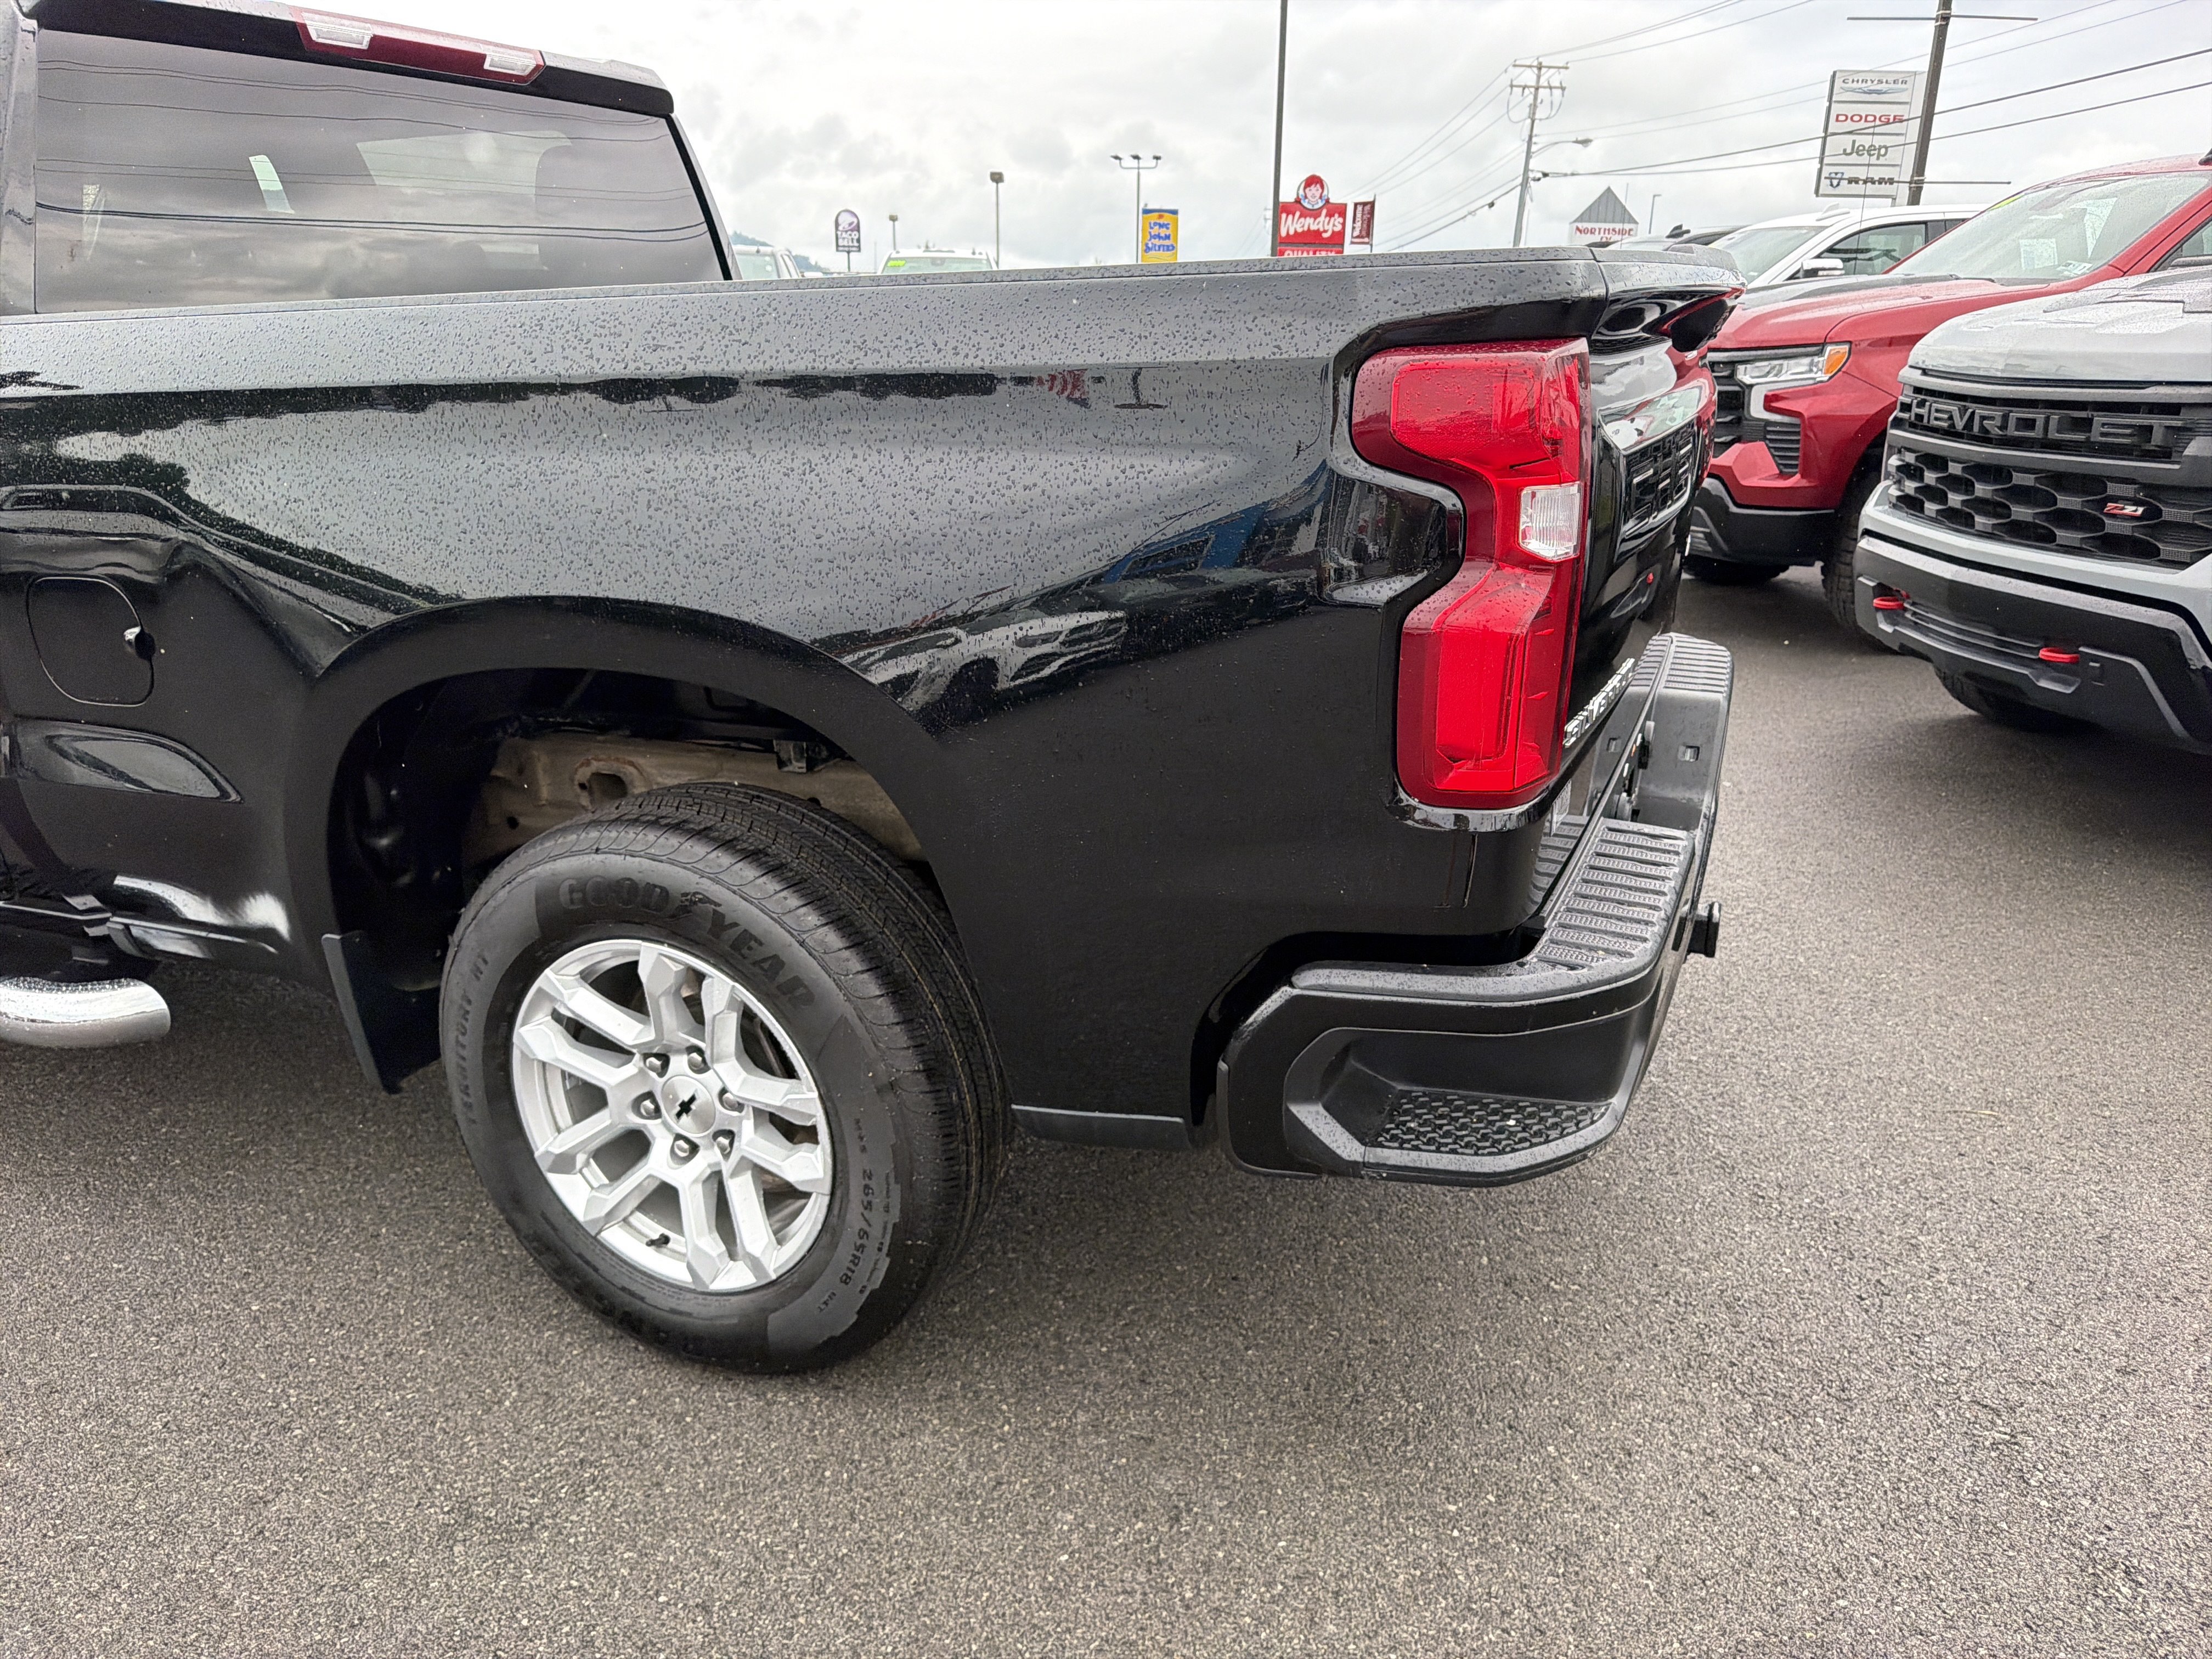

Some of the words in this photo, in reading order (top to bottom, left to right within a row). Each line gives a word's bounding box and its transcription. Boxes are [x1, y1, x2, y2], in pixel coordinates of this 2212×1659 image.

[1835, 114, 1905, 123] DODGE
[1842, 139, 1889, 161] Jeep
[1847, 176, 1895, 185] RAM
[1280, 208, 1344, 238] Wendy's
[1896, 396, 2184, 446] CHEVROLET
[2103, 503, 2145, 516] Z71
[839, 1168, 875, 1286] 265/65R18
